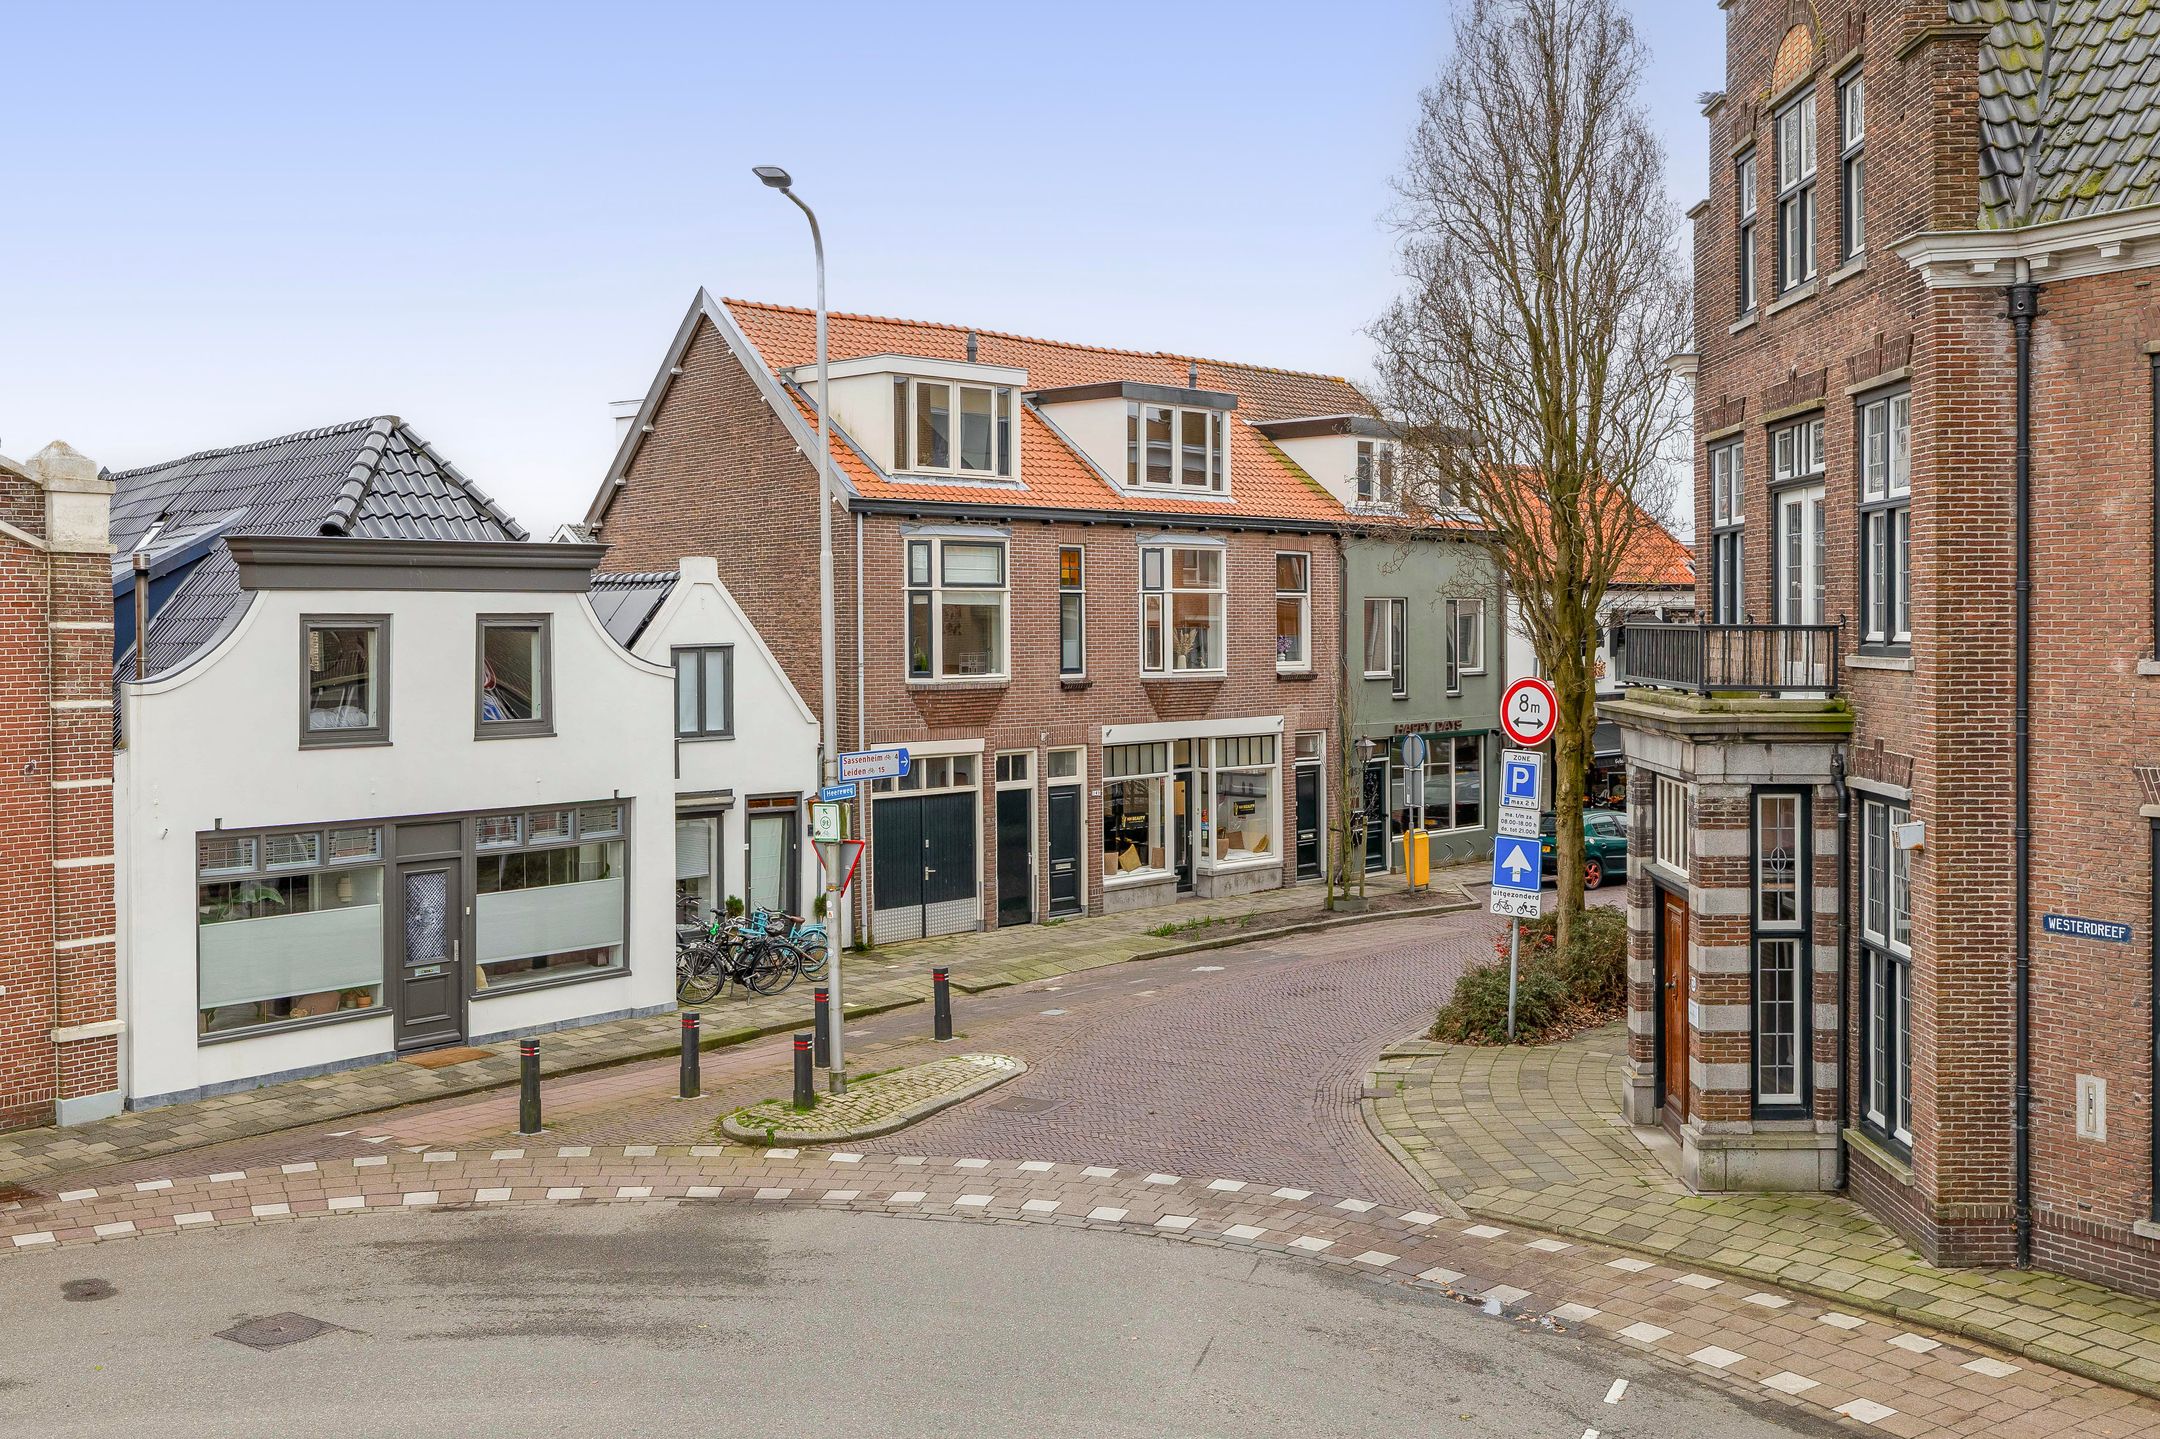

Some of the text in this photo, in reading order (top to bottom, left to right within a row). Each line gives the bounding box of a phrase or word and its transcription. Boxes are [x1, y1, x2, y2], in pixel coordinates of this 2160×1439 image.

[1394, 720, 1463, 735] HAPPY DAYS
[843, 754, 883, 765] Sassenheim
[843, 768, 867, 777] Leiden
[1512, 766, 1529, 793] P
[826, 787, 853, 797] Heereweg
[1492, 890, 1539, 901] uitgezonderd
[2048, 917, 2126, 939] WESTERDREEF
